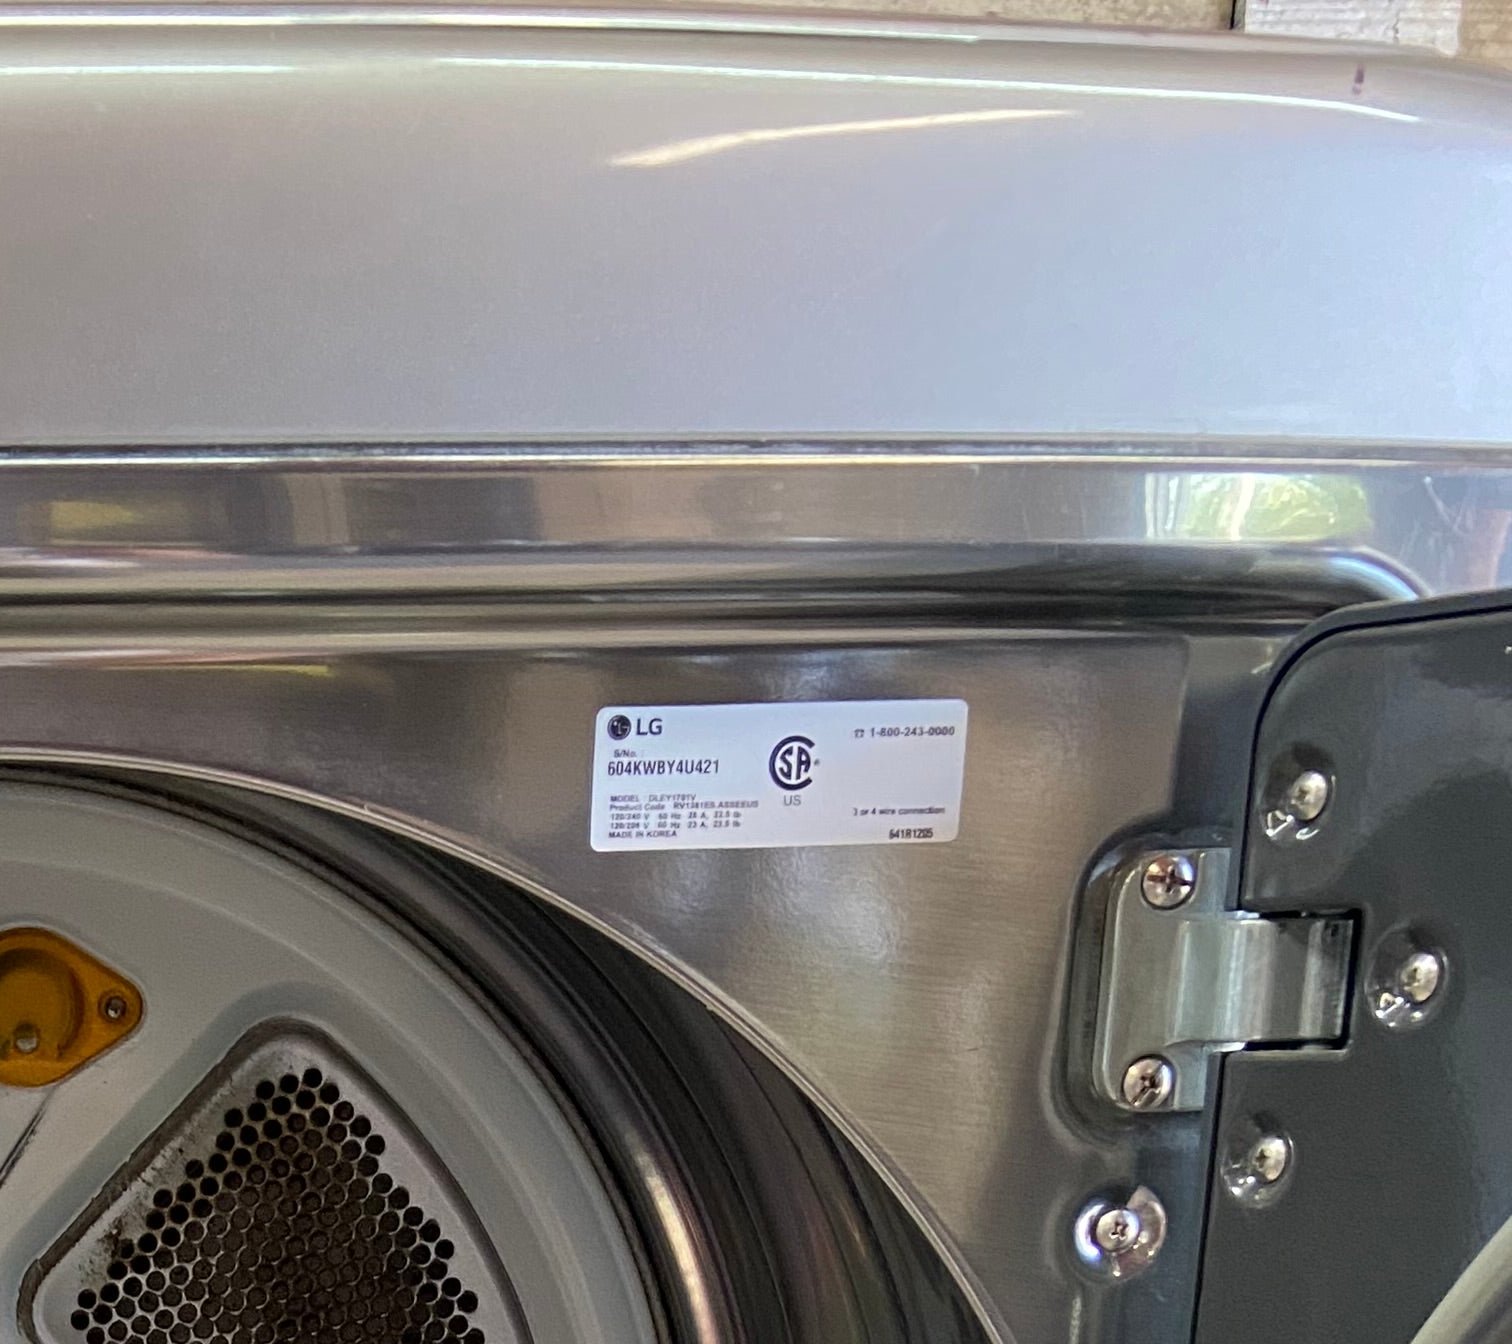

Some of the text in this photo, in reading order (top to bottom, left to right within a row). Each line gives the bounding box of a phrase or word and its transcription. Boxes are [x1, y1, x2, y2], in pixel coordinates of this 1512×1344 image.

[635, 718, 663, 736] LG
[871, 727, 955, 737] 1-800-243-0000
[608, 760, 719, 777] 604KWBY4U421
[783, 795, 801, 806] US
